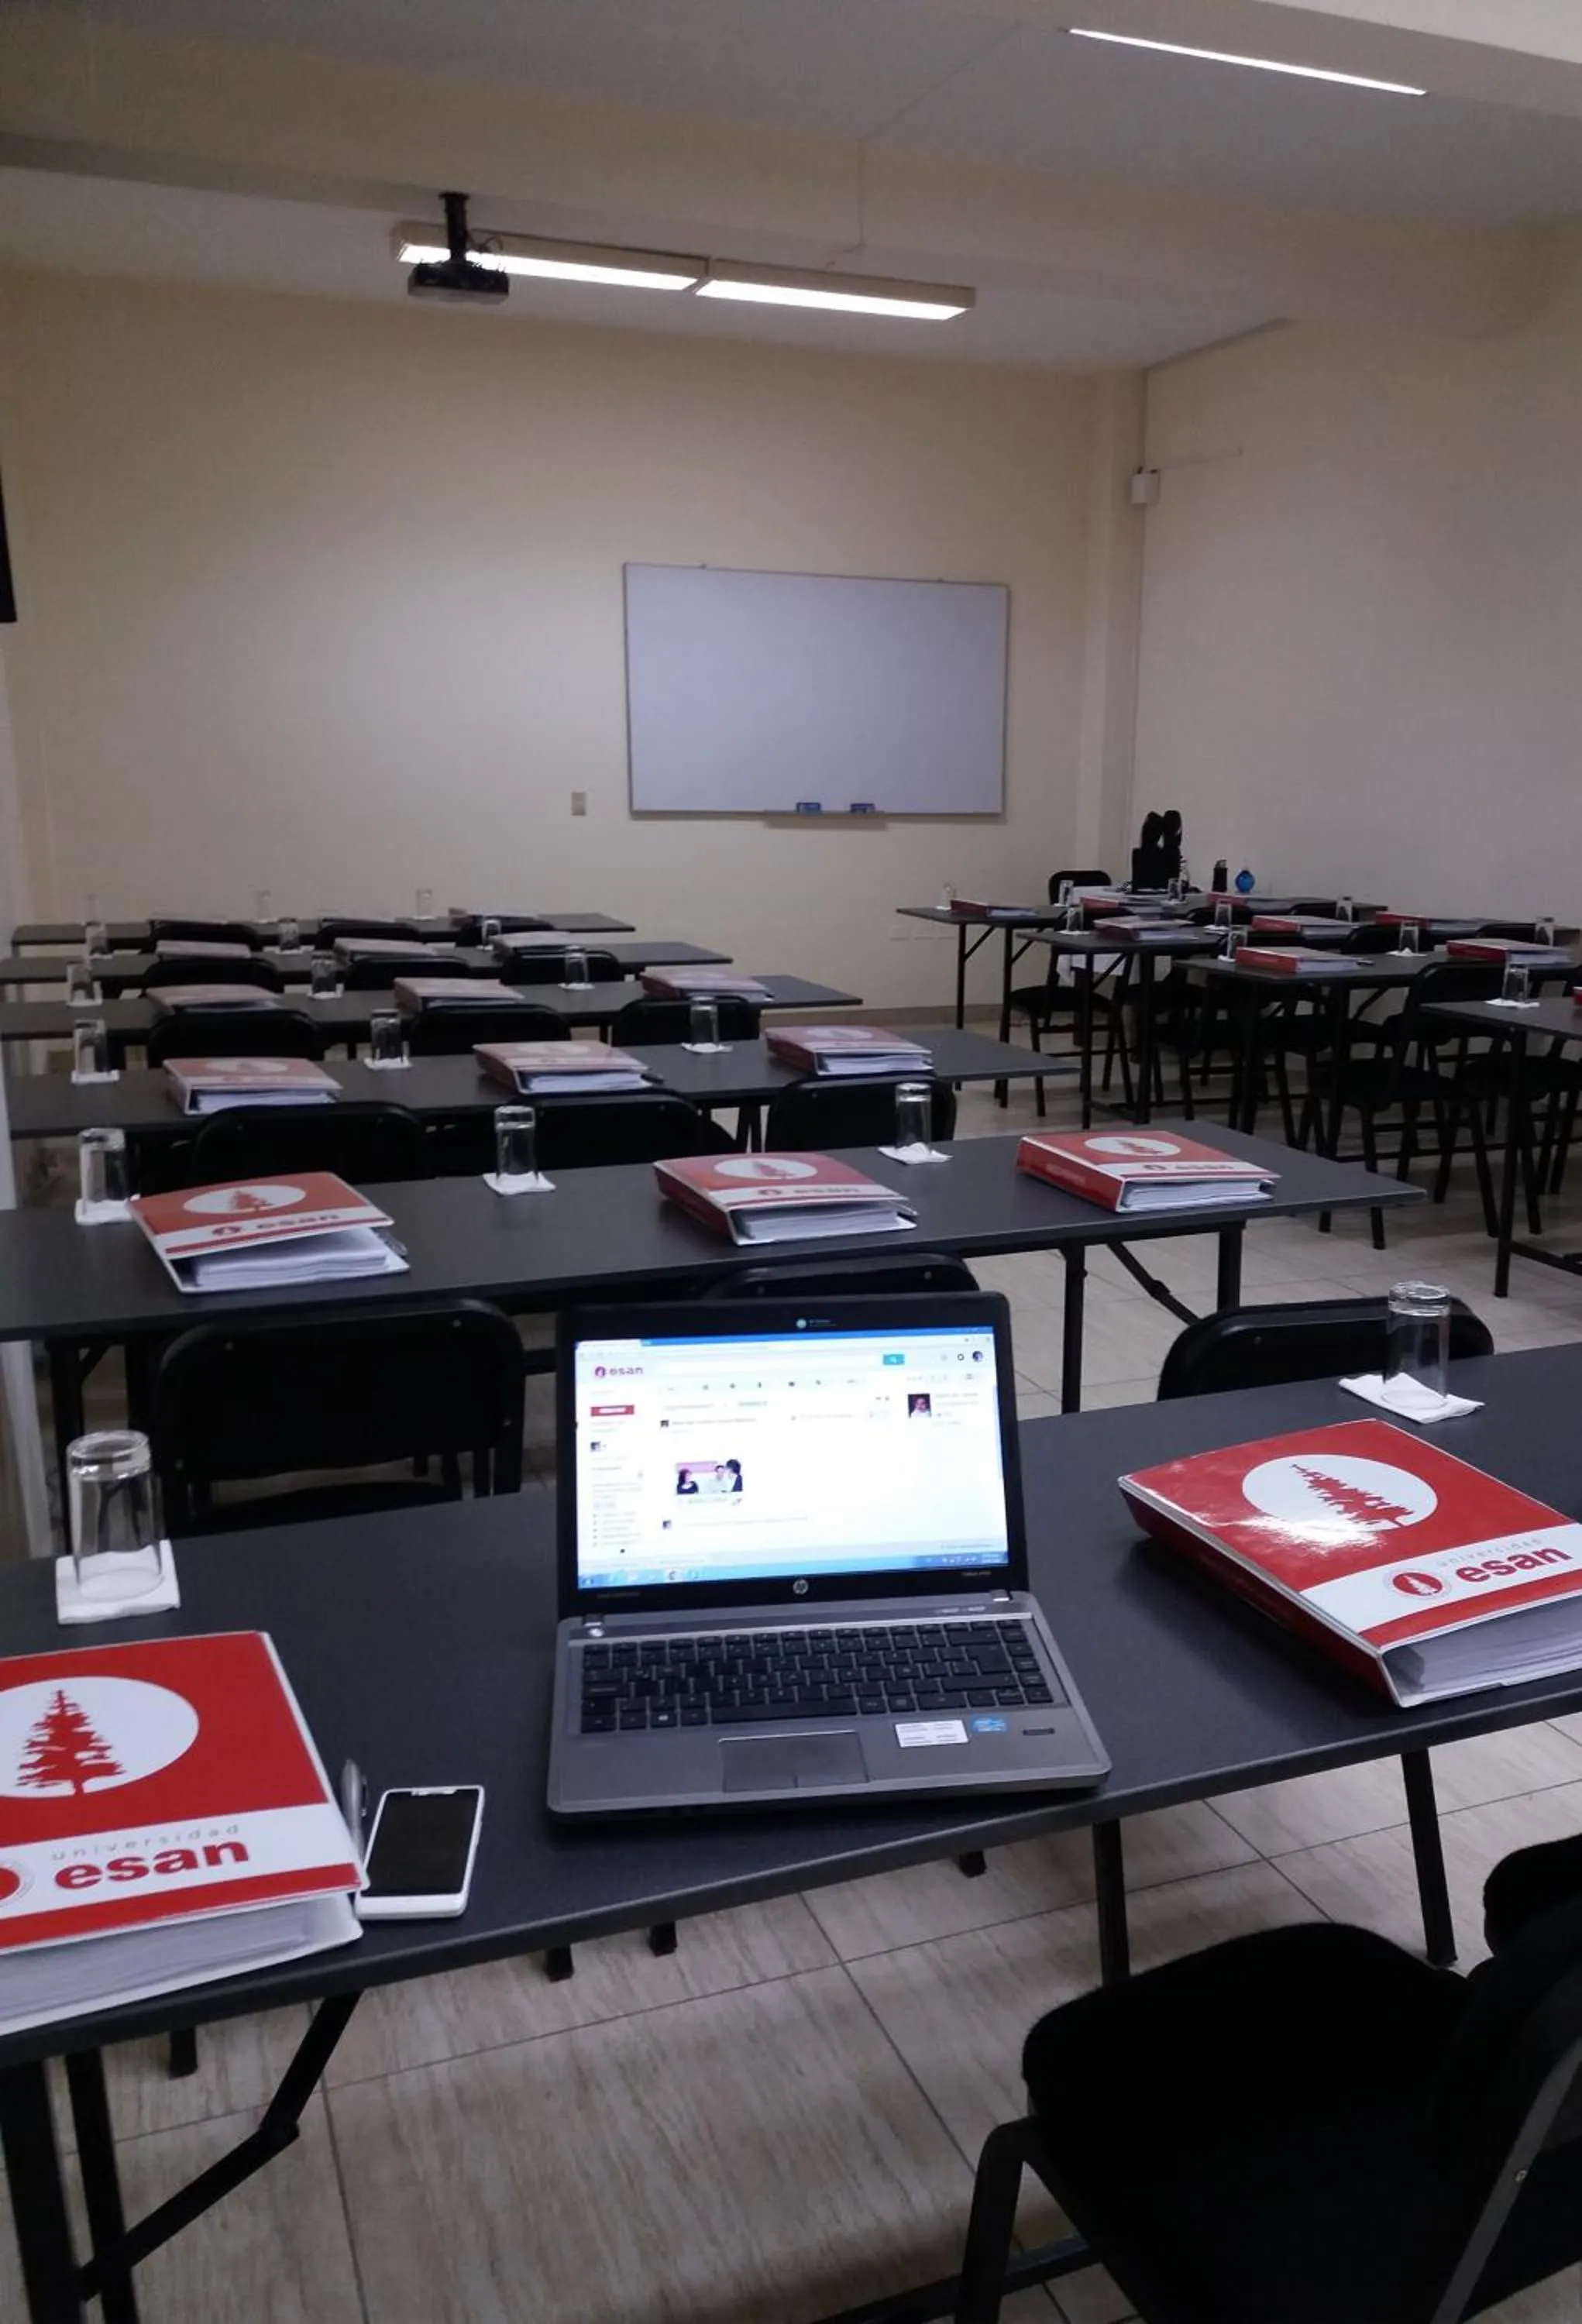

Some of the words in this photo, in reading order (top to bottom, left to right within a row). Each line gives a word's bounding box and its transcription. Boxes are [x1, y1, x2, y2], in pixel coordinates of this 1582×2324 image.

[609, 1367, 644, 1376] esan
[1456, 1547, 1573, 1583] esan
[51, 1824, 240, 1861] universidad
[54, 1841, 249, 1890] esan
